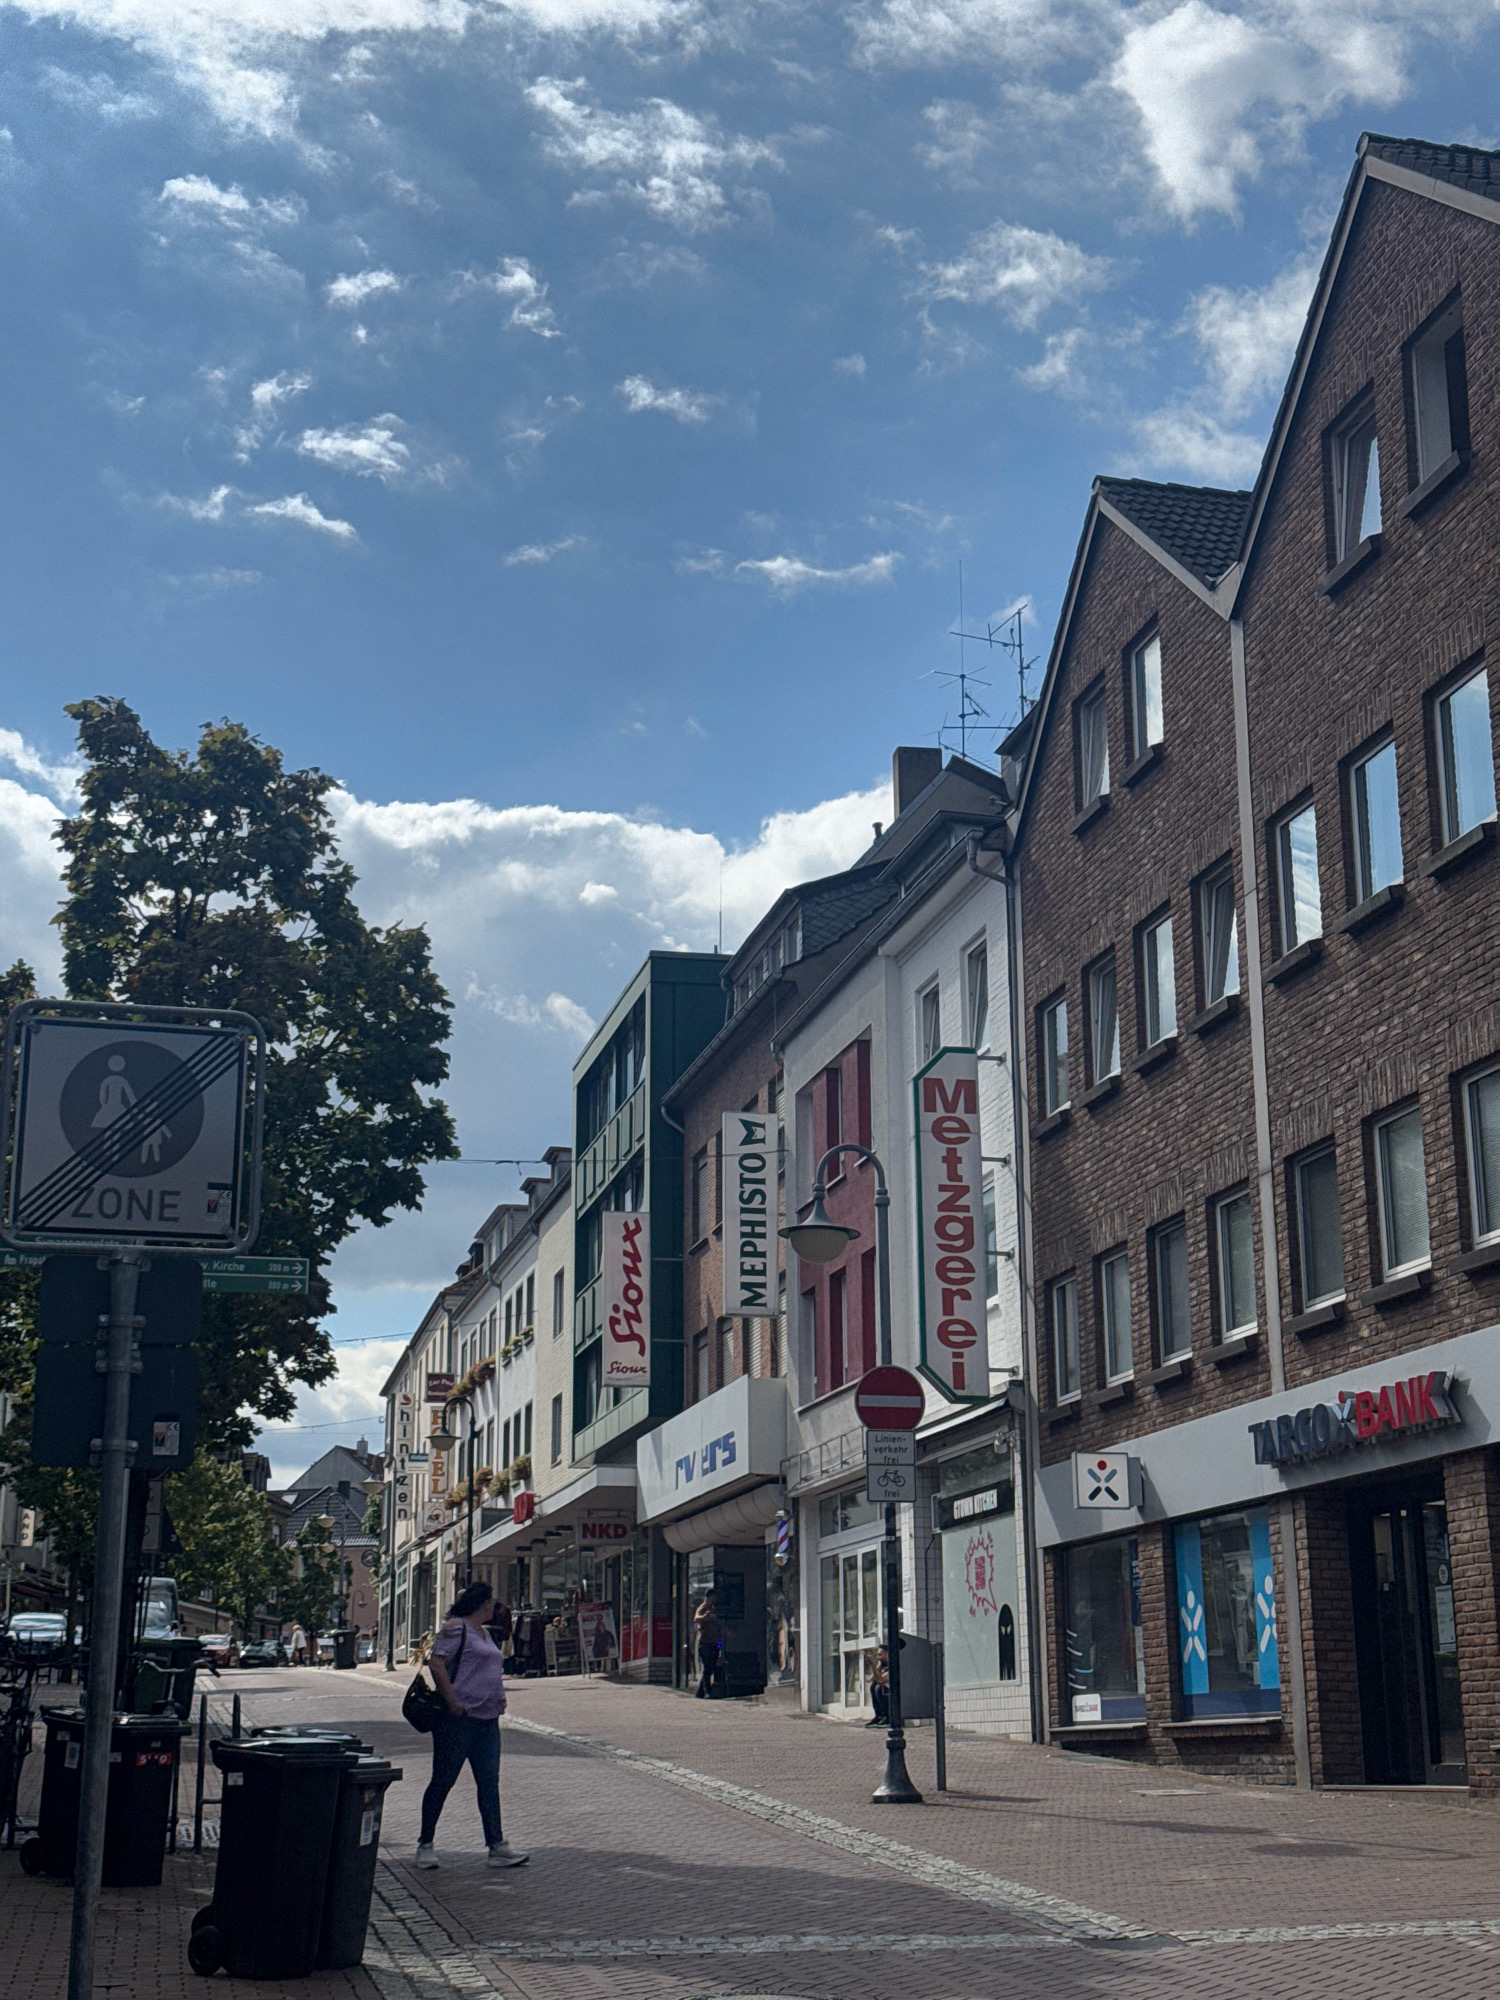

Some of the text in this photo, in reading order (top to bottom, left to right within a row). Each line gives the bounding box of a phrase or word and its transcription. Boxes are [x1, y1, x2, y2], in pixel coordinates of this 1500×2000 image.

[72, 1187, 181, 1222] ZONE
[738, 1152, 767, 1309] MEPHISTO
[923, 1077, 978, 1391] Metzgerei
[213, 1260, 245, 1272] Kirche
[608, 1217, 646, 1357] Sioux
[607, 1361, 648, 1374] Sioux
[875, 1433, 907, 1443] Linien-
[431, 1409, 446, 1494] HEL
[873, 1445, 909, 1454] verkehr
[883, 1455, 900, 1464] frei
[884, 1488, 900, 1498] frei
[581, 1523, 628, 1539] NKD
